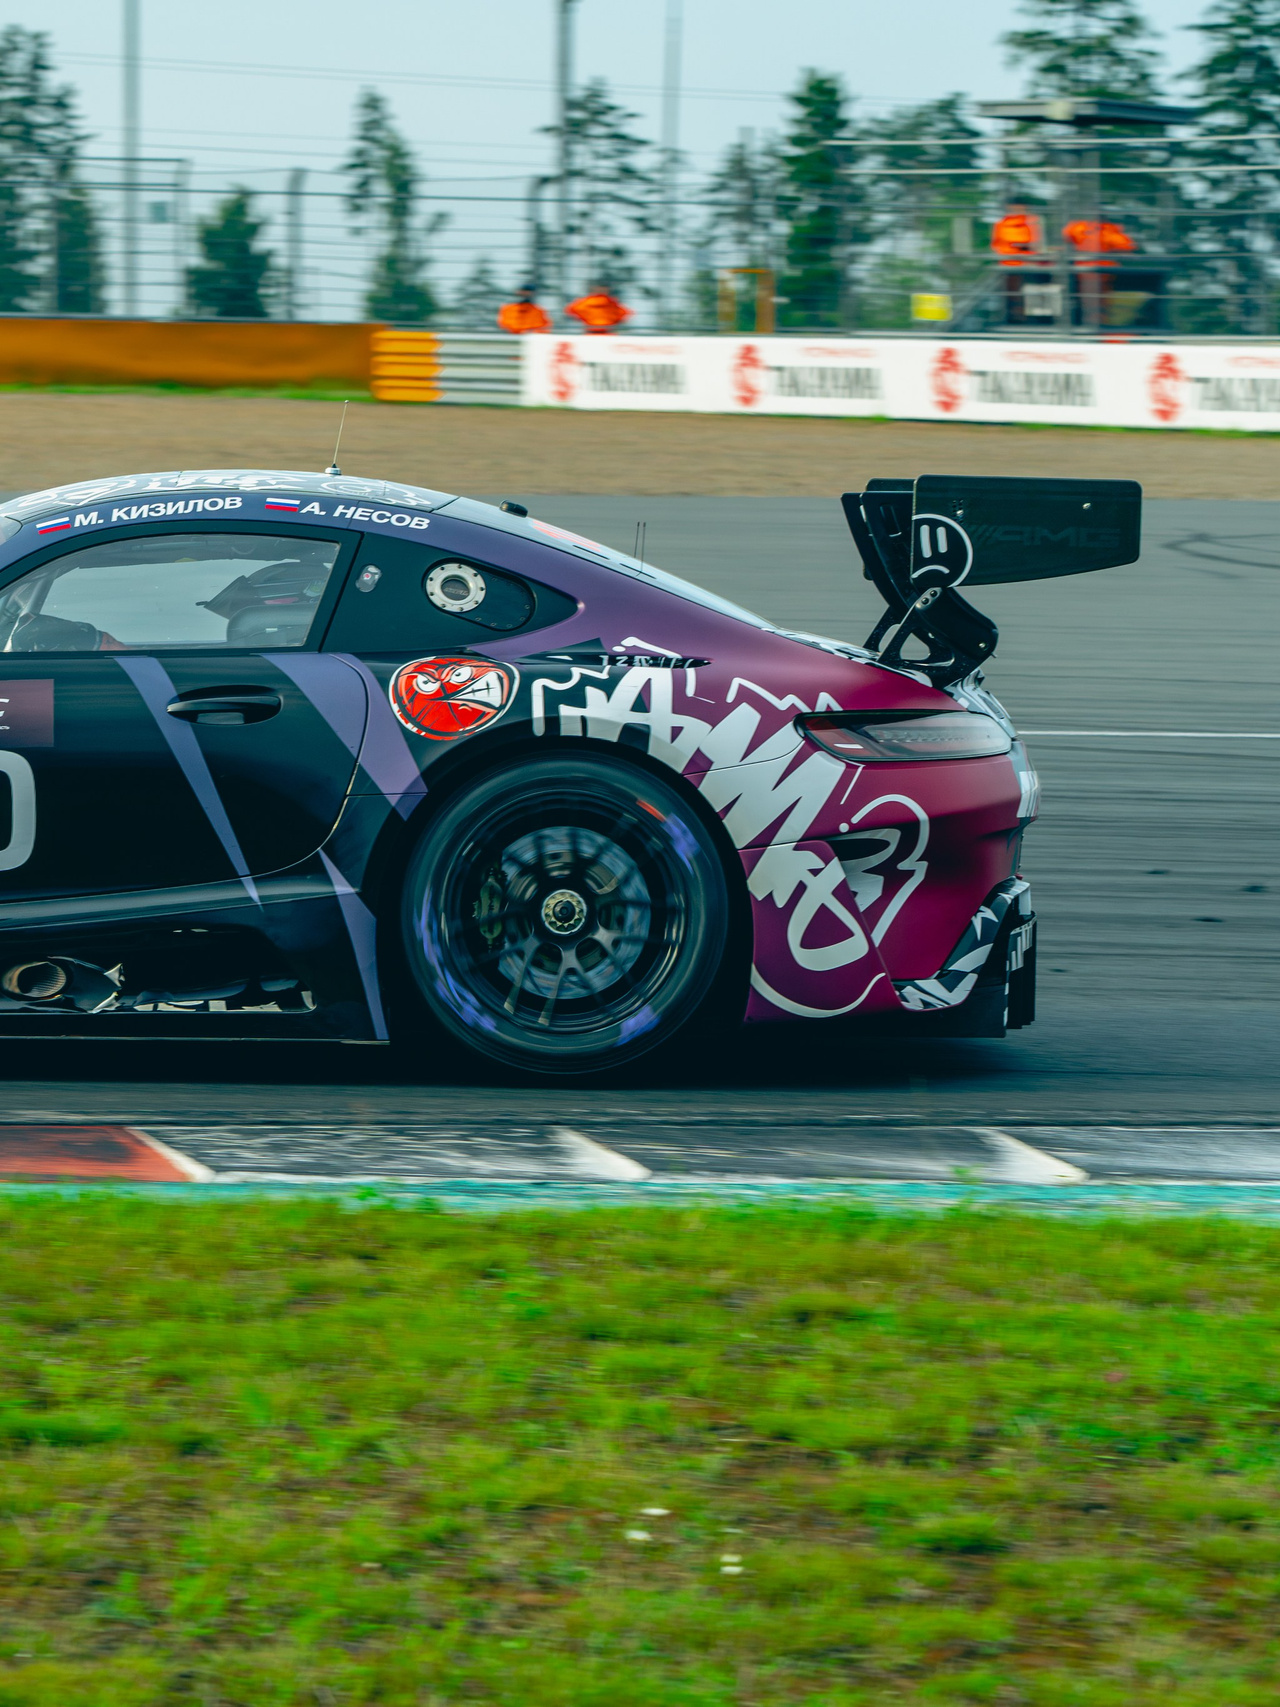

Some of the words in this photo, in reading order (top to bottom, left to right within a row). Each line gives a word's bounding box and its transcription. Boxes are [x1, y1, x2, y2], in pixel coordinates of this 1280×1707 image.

[73, 511, 104, 529] М.
[111, 496, 243, 521] КИЗИЛОВ
[299, 500, 327, 516] А.
[333, 504, 431, 530] НЕСОВ
